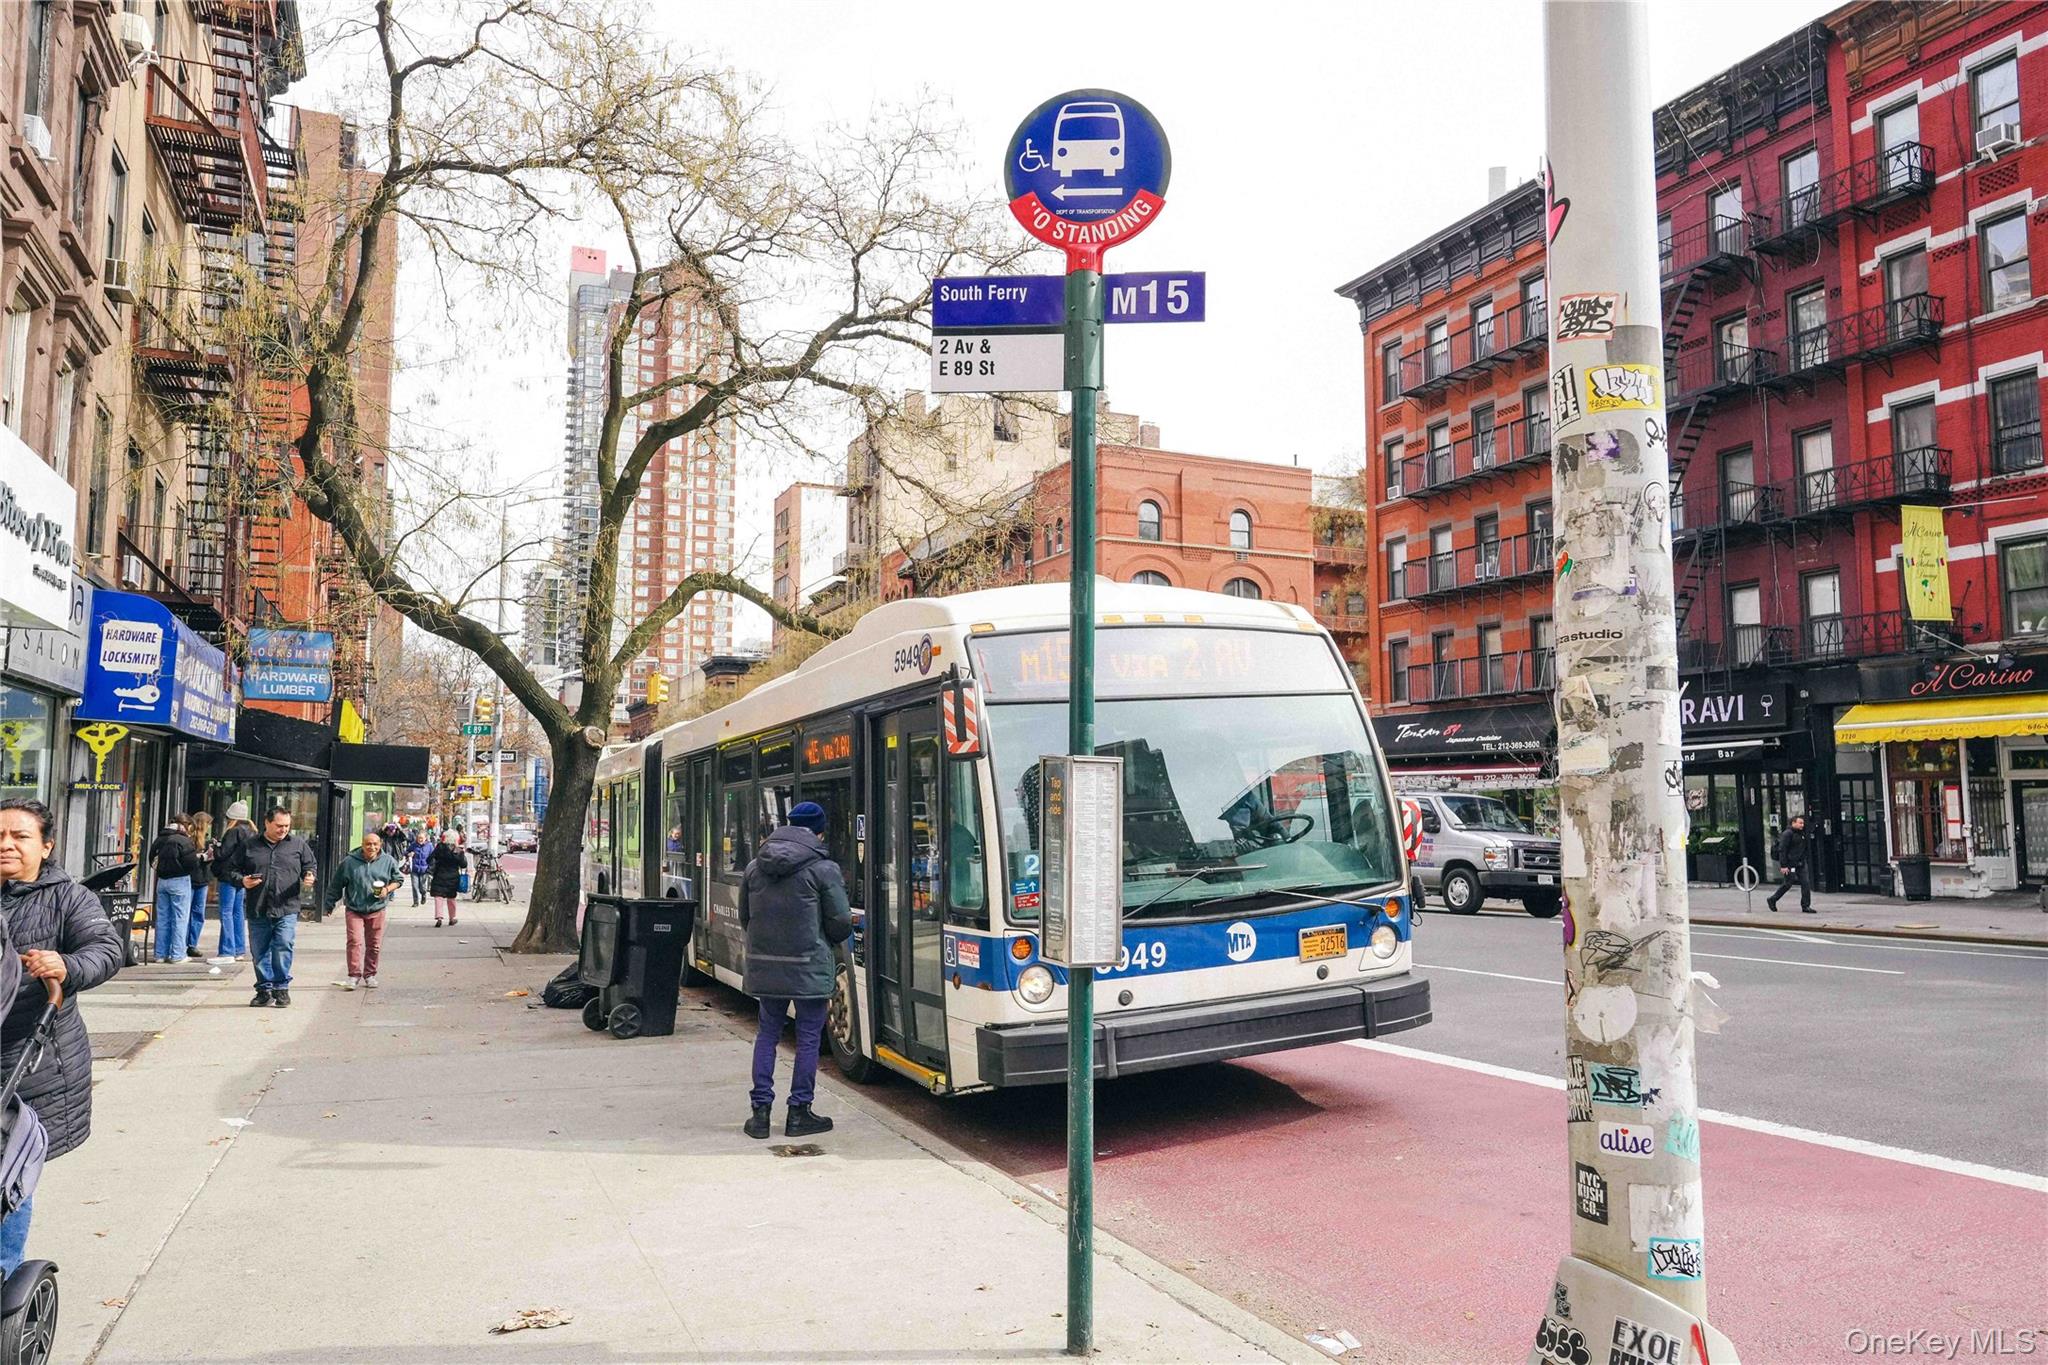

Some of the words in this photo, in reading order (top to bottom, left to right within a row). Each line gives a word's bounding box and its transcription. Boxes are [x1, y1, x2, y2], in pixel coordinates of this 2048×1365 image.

[1031, 201, 1051, 230] O
[1052, 199, 1153, 243] STANDING
[940, 285, 982, 302] South
[988, 284, 1028, 303] Ferry
[1112, 279, 1190, 315] M15
[939, 339, 949, 354] 2
[954, 339, 974, 354] Av
[979, 339, 991, 354] &
[939, 361, 948, 376] E
[954, 360, 973, 376] 89
[979, 360, 995, 375] St
[105, 628, 158, 644] HARDWARE
[23, 628, 80, 671] SALON
[102, 649, 158, 665] LOCKSMITH
[251, 646, 330, 661] LOCKSMITH
[894, 643, 920, 673] 5949
[1181, 637, 1201, 679] 2
[250, 671, 328, 685] HARDWARE
[1949, 664, 2035, 690] Carino
[263, 684, 316, 696] LUMBER
[473, 726, 482, 734] 89
[1395, 722, 1441, 743] Tenzan
[1717, 750, 1735, 758] Bar
[112, 905, 134, 915] SALON
[959, 940, 980, 954] CAUTION
[1227, 932, 1252, 954] MTA
[1096, 942, 1167, 975] 949
[1600, 1129, 1654, 1155] alise
[1579, 1170, 1601, 1188] NYC
[1577, 1183, 1604, 1203] KUSH
[1582, 1201, 1600, 1217] CO.
